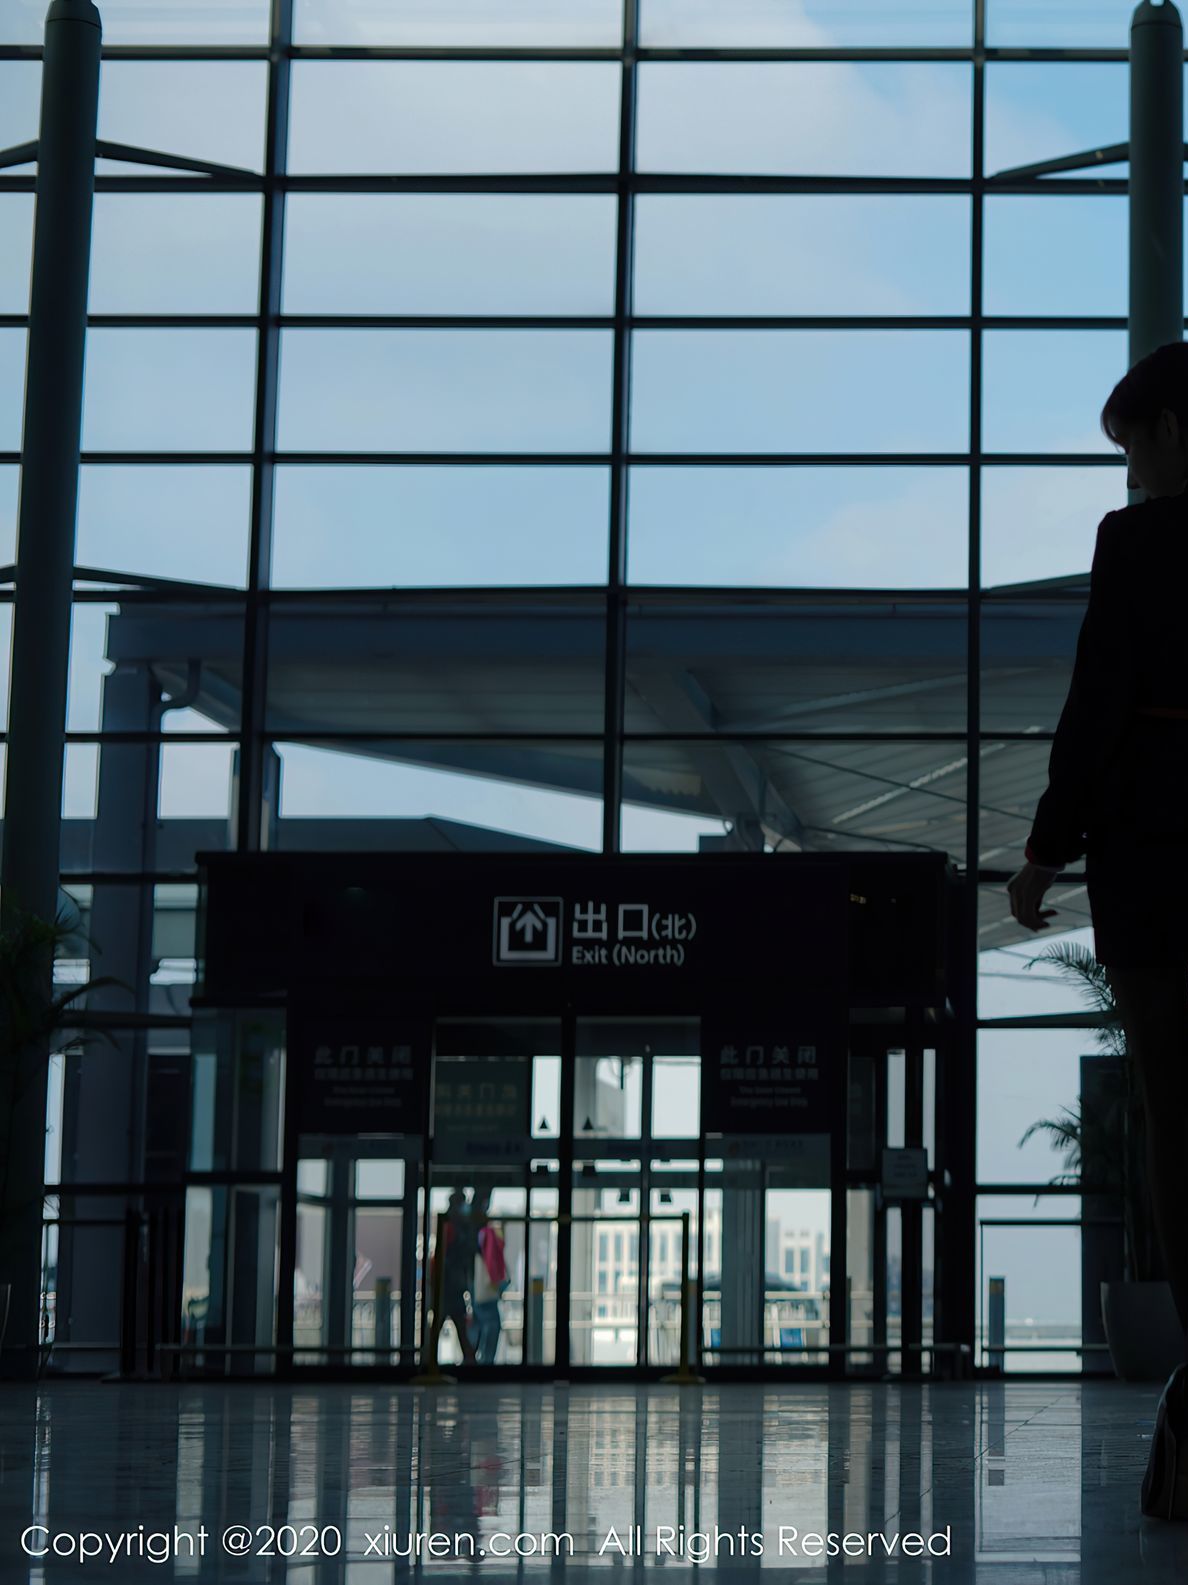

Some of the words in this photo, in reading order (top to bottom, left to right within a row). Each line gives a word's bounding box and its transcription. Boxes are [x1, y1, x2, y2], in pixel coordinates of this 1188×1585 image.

[572, 900, 697, 941] 出口(北)
[572, 944, 608, 966] Exit
[612, 942, 686, 968] (North)
